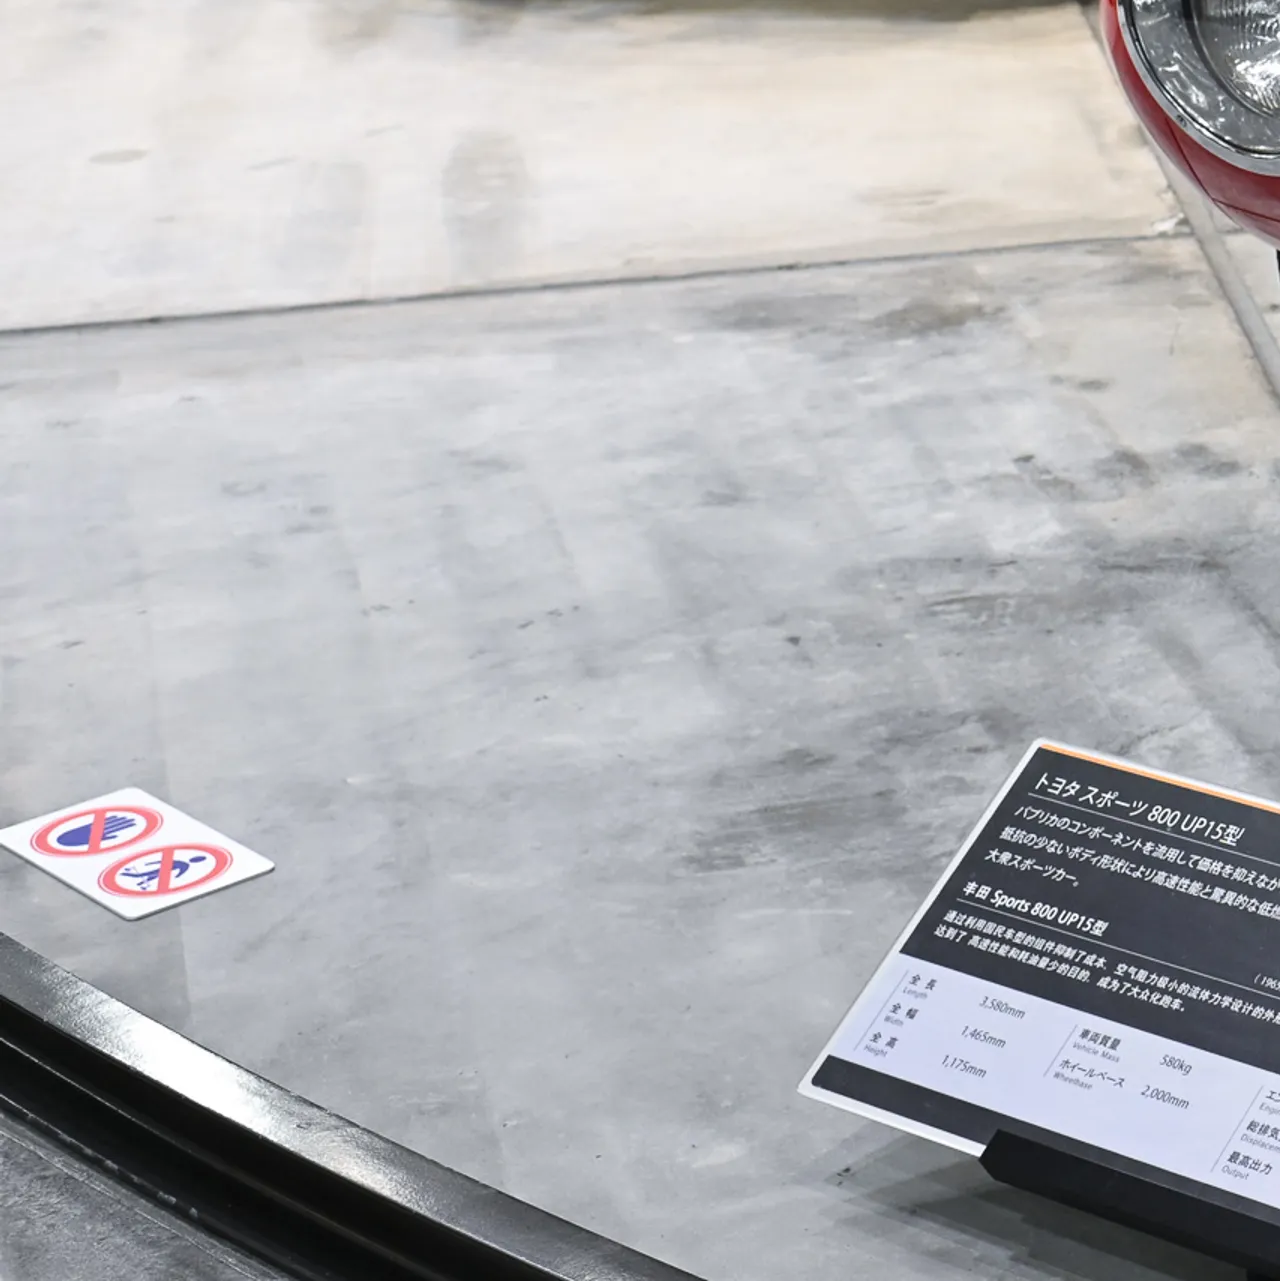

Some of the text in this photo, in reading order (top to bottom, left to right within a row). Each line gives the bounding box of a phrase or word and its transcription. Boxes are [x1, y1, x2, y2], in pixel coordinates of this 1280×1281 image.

[1034, 772, 1245, 846] トヨタ スポーツ 800 UP15型
[989, 889, 1031, 913] Sports
[1030, 902, 1058, 920] 800
[1057, 909, 1109, 937] UP15型
[902, 986, 928, 999] Length
[979, 995, 1026, 1019] 3,580mm
[961, 1025, 1006, 1048] 1,465mm
[1079, 1028, 1121, 1051] 車両質量
[1072, 1041, 1120, 1063] Vehicle Mass
[941, 1054, 987, 1078] 1,175mm
[1059, 1058, 1125, 1088] ホイールベース
[1159, 1054, 1192, 1076] 580kg
[1140, 1084, 1189, 1109] 2,000mm
[1221, 1164, 1249, 1180] Output
[1226, 1150, 1273, 1175] 最高出力
